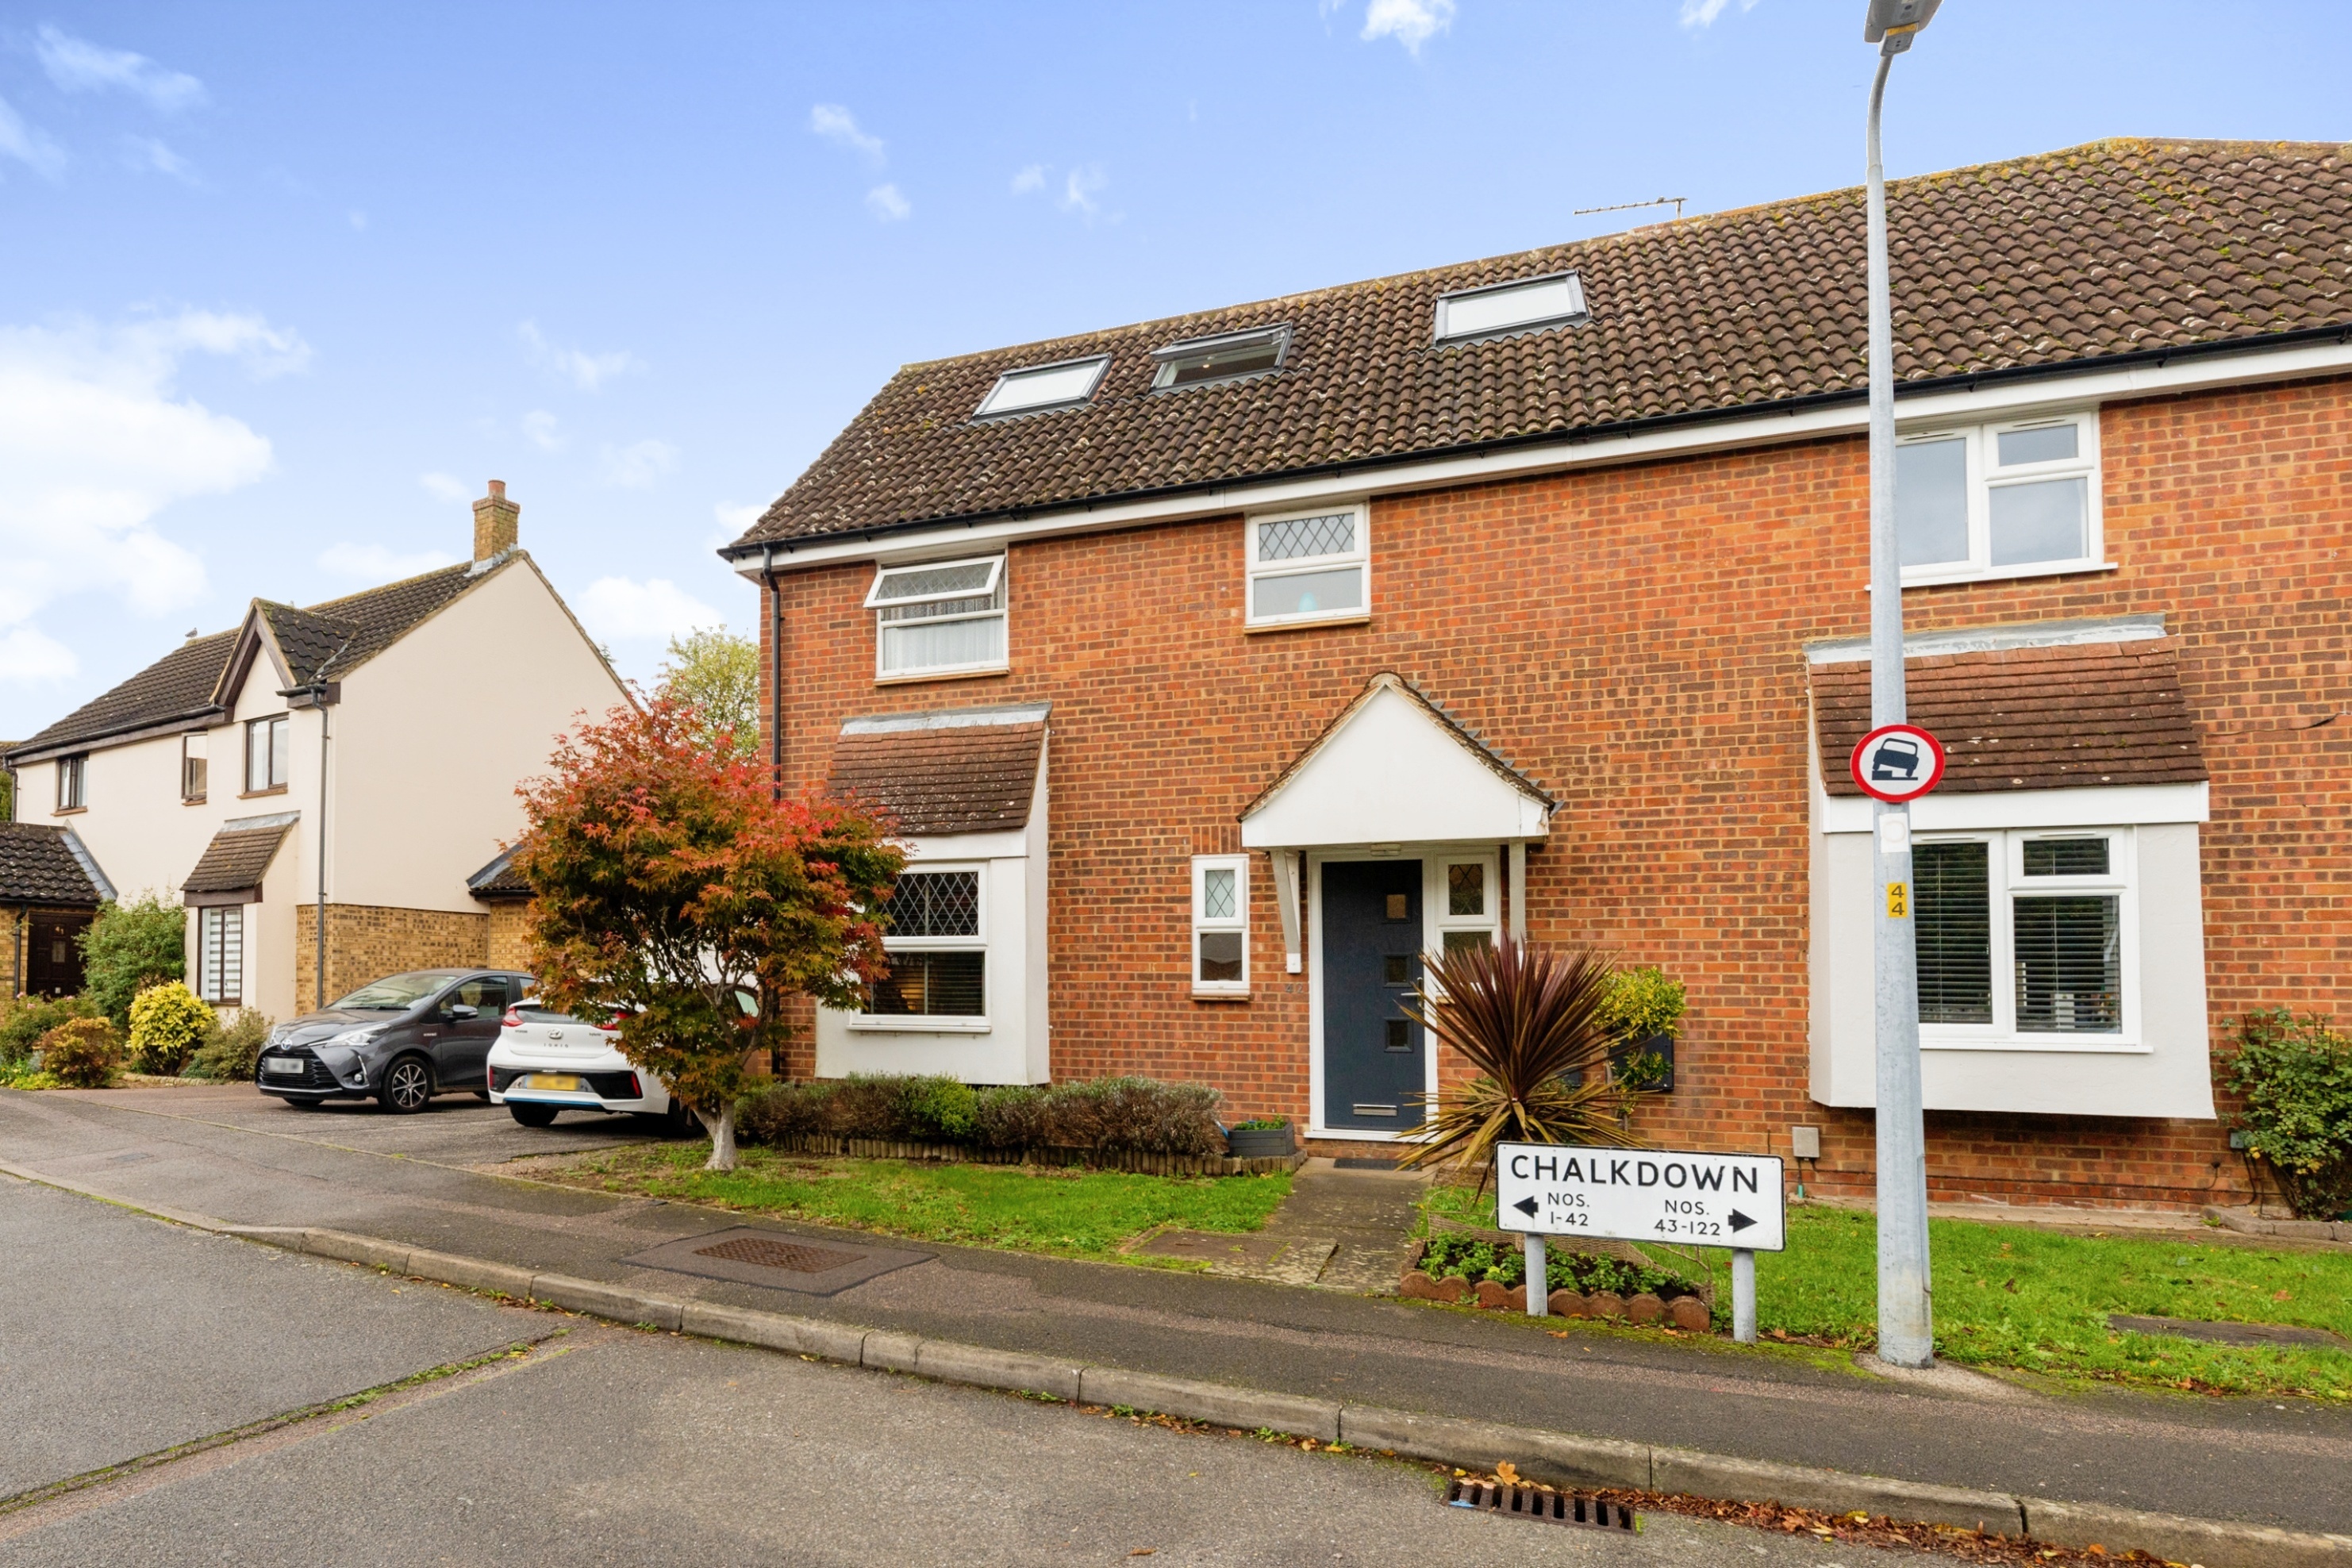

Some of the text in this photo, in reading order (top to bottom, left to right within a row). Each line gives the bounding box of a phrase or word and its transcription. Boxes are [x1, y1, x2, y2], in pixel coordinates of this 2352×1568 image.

[1511, 1155, 1758, 1193] CHALKDOWN
[1547, 1192, 1589, 1208] NOS.
[1665, 1199, 1709, 1216] NOS.
[1551, 1211, 1589, 1227] 1-42
[1654, 1219, 1720, 1236] 43-122
